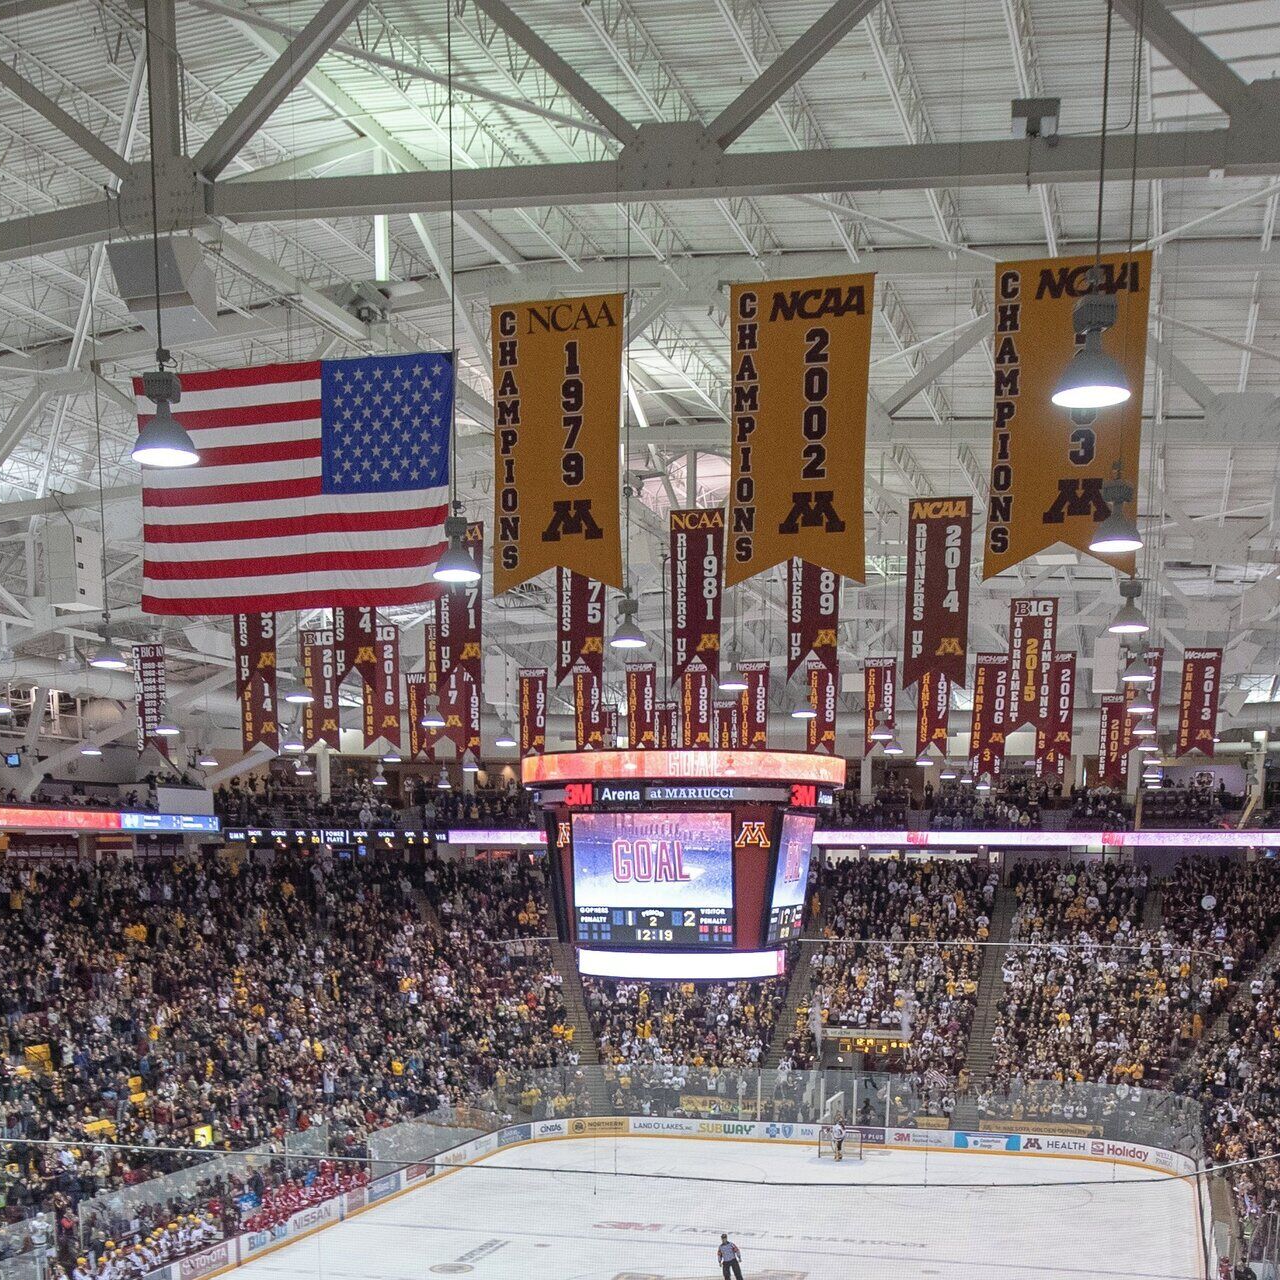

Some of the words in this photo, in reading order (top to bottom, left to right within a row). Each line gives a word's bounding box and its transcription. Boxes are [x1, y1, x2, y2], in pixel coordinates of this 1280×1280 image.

[525, 301, 617, 335] NCAA
[768, 284, 865, 322] NCAA
[558, 340, 586, 488] 1979
[801, 326, 830, 480] 2002
[989, 270, 1020, 554] CHAMPIONS
[496, 310, 521, 571] CHAMPIONS
[732, 292, 759, 564] CHAMPIONS
[541, 499, 604, 543] M
[671, 512, 724, 530] NCAA
[777, 490, 846, 535] M
[912, 501, 967, 519] NCAA
[677, 533, 686, 629] RUNNERS
[703, 534, 718, 620] 1981
[913, 523, 927, 621] RUNNERS
[942, 525, 962, 613] 2014
[336, 650, 345, 676] UP
[441, 646, 450, 672] UP
[562, 641, 571, 667] UP
[677, 638, 686, 665] UP
[791, 633, 801, 660] UP
[911, 630, 923, 658] UP
[1039, 616, 1053, 718] CHAMPIONS
[240, 655, 250, 681] UP
[323, 649, 333, 709] 2015
[383, 645, 394, 705] 2016
[1010, 617, 1023, 722] TOURNAMENT
[1023, 638, 1038, 702] 2015
[132, 647, 144, 751] CHAMPIONS
[470, 684, 479, 730] 1954
[536, 680, 545, 728] 1970
[591, 676, 599, 724] 1975
[644, 675, 653, 723] 1981
[699, 675, 707, 724] 1983
[756, 675, 765, 723] 1988
[825, 673, 834, 722] 1989
[938, 673, 947, 719] 1997
[973, 668, 985, 748] CHAMPIONS
[994, 671, 1006, 724] 2006
[1059, 669, 1071, 723] 2007
[1180, 663, 1193, 747] CHAMPIONS
[1200, 666, 1215, 721] 2013
[1099, 708, 1108, 778] TOURNAMENT
[1110, 719, 1119, 762] 2007
[564, 784, 593, 805] 3M
[601, 788, 640, 800] Arena
[650, 789, 662, 799] at
[665, 788, 735, 799] MARIUCCI
[791, 785, 816, 807] 3M
[735, 821, 771, 848] M
[613, 839, 691, 883] GOAL
[637, 930, 673, 941] 12:19
[649, 917, 658, 927] 2
[684, 911, 695, 927] 2
[588, 1121, 624, 1129] NORTHERN
[698, 1122, 755, 1135] SUBWAY
[894, 1133, 911, 1142] 3M
[1047, 1140, 1086, 1151] HEALTH
[1107, 1144, 1149, 1161] Holiday
[293, 1204, 331, 1231] NISSAN
[194, 1244, 227, 1267] TOYOTA
